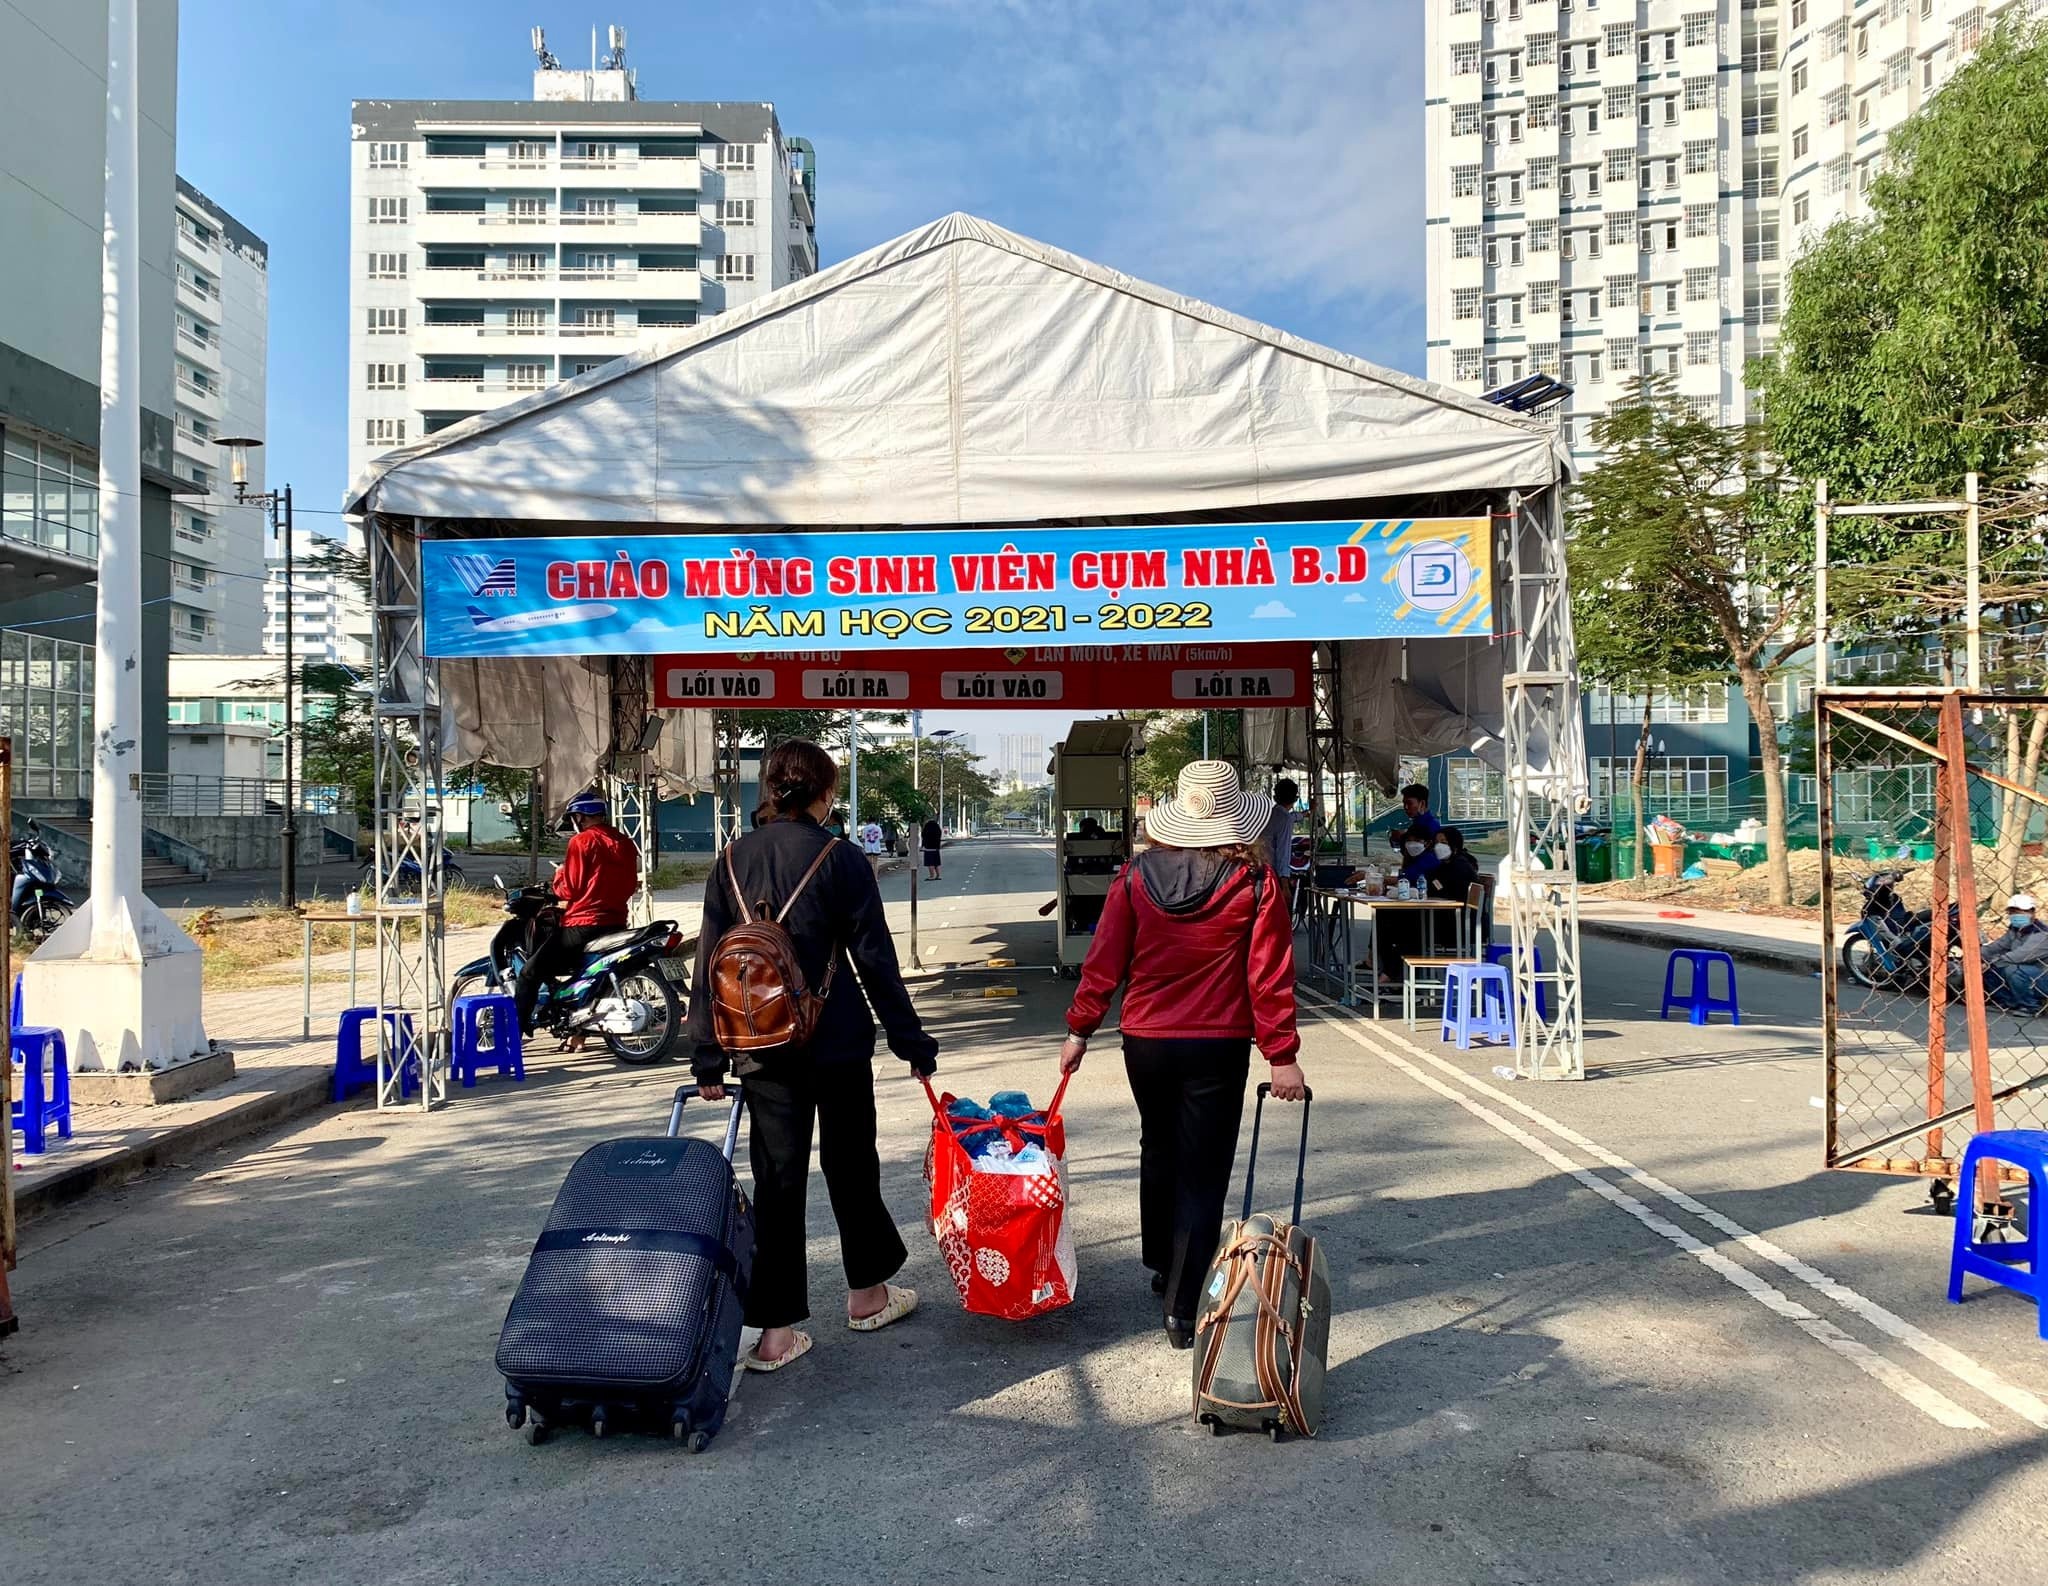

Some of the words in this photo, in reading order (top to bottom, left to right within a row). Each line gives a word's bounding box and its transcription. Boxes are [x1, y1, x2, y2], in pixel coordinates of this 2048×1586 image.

[546, 550, 670, 600] CHÀO
[684, 548, 815, 598] MỪNG
[828, 555, 938, 597] SINH
[950, 543, 1057, 594] VIÊN
[1070, 549, 1168, 599] CỤM
[1182, 537, 1276, 588] NHÀ
[1290, 544, 1369, 587] B.D
[486, 589, 517, 597] KTX
[704, 605, 824, 638] NĂM
[840, 606, 952, 640] HỌC
[1123, 645, 1143, 661] XE
[1186, 647, 1233, 662] (5km/h)
[682, 670, 715, 697] LỐI
[721, 672, 761, 697] VÀO
[823, 671, 856, 697] LỐI
[863, 678, 889, 697] RA
[957, 672, 995, 698] LỐI
[1002, 674, 1046, 698] VÀO
[1195, 670, 1233, 697] LỐI
[1241, 676, 1272, 696] RA
